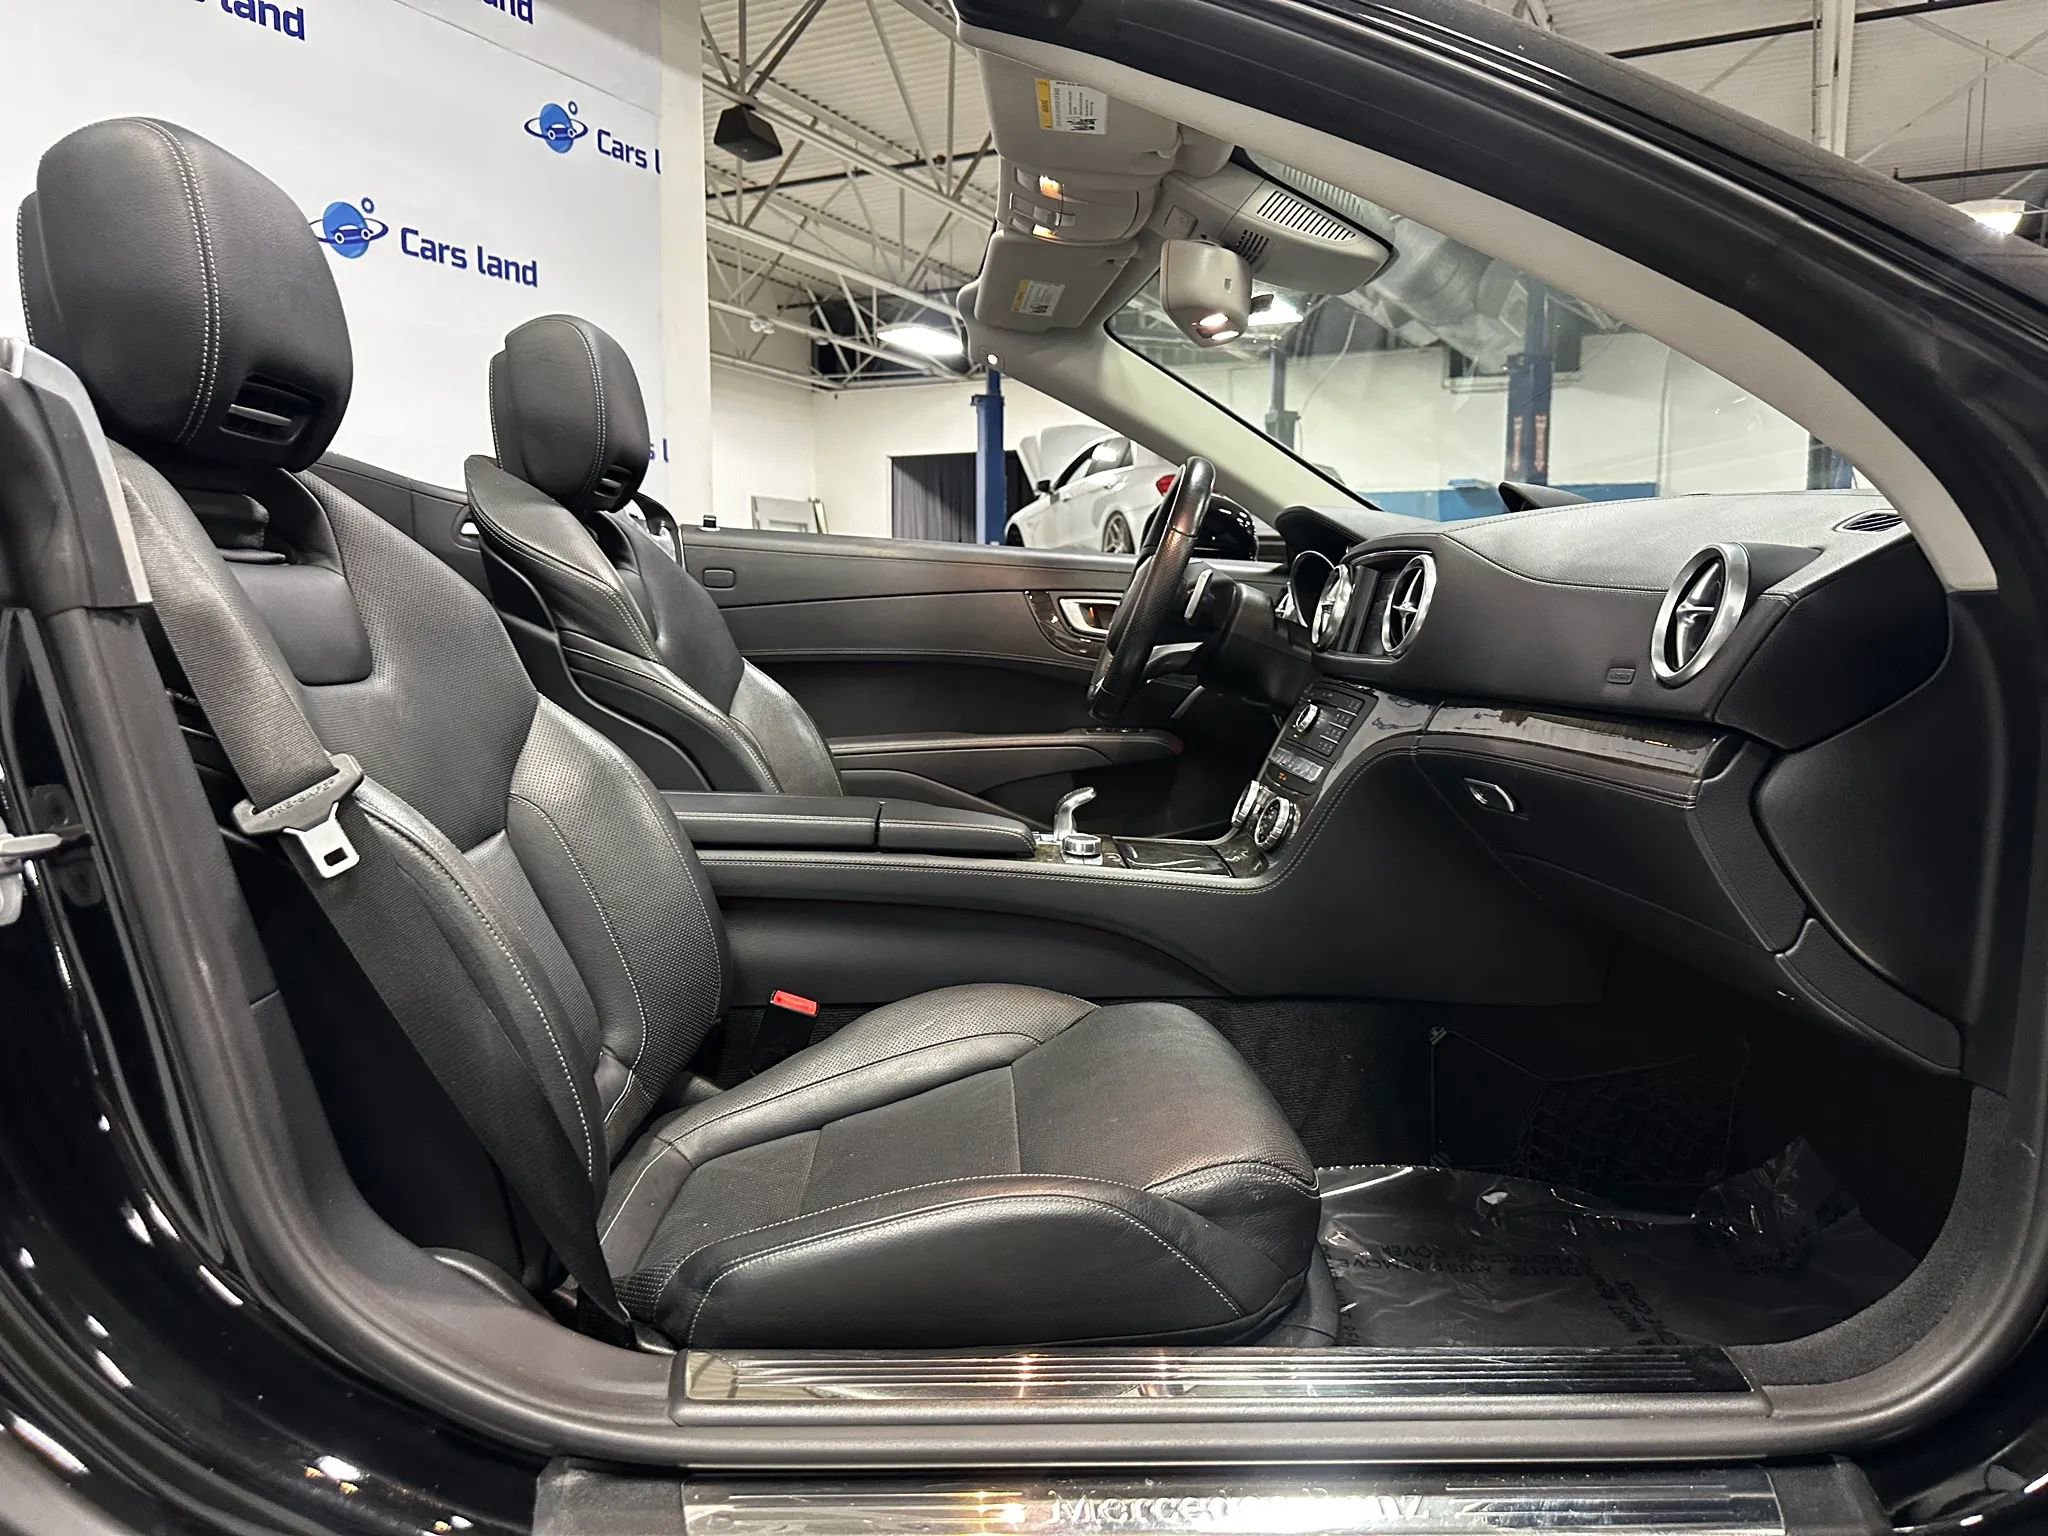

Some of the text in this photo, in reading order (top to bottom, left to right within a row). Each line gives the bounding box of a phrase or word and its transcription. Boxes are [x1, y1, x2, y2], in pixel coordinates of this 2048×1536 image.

[597, 128, 648, 169] Cars
[400, 226, 538, 288] Cars land
[1042, 1489, 1431, 1526] Mercednz
